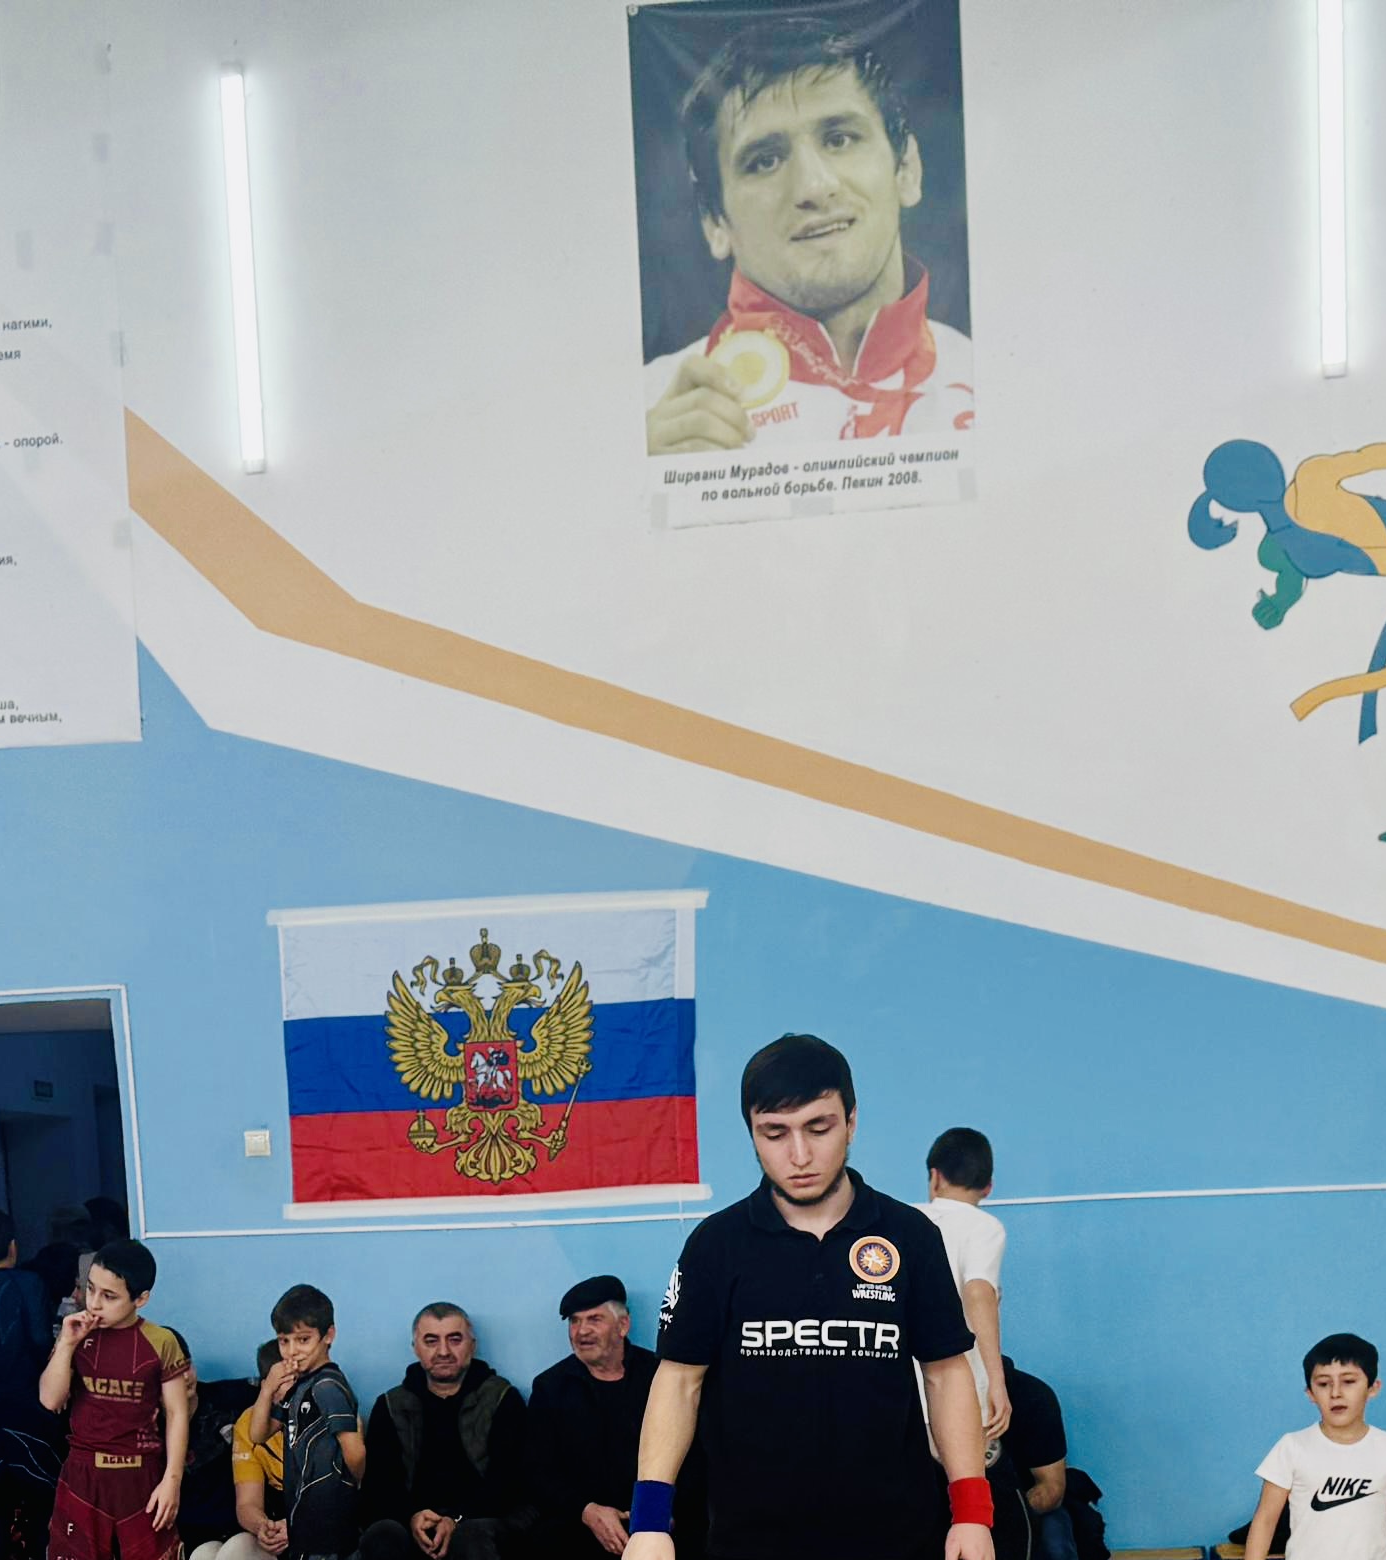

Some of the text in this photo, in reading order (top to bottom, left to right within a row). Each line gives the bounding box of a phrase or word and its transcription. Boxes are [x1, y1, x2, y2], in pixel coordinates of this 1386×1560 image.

[751, 402, 800, 428] SPORT
[664, 468, 726, 485] Ширвани
[730, 462, 789, 481] Мурадов
[803, 452, 895, 473] олимпийский
[900, 449, 959, 465] чемпион
[701, 471, 922, 501] по вольной борьбе. Пекин 2008.
[9, 713, 62, 724] вечным,
[852, 1289, 896, 1302] WRESTLING
[741, 1319, 900, 1350] SPECTR
[1321, 1476, 1372, 1496] NIKE
[67, 1523, 74, 1535] F
